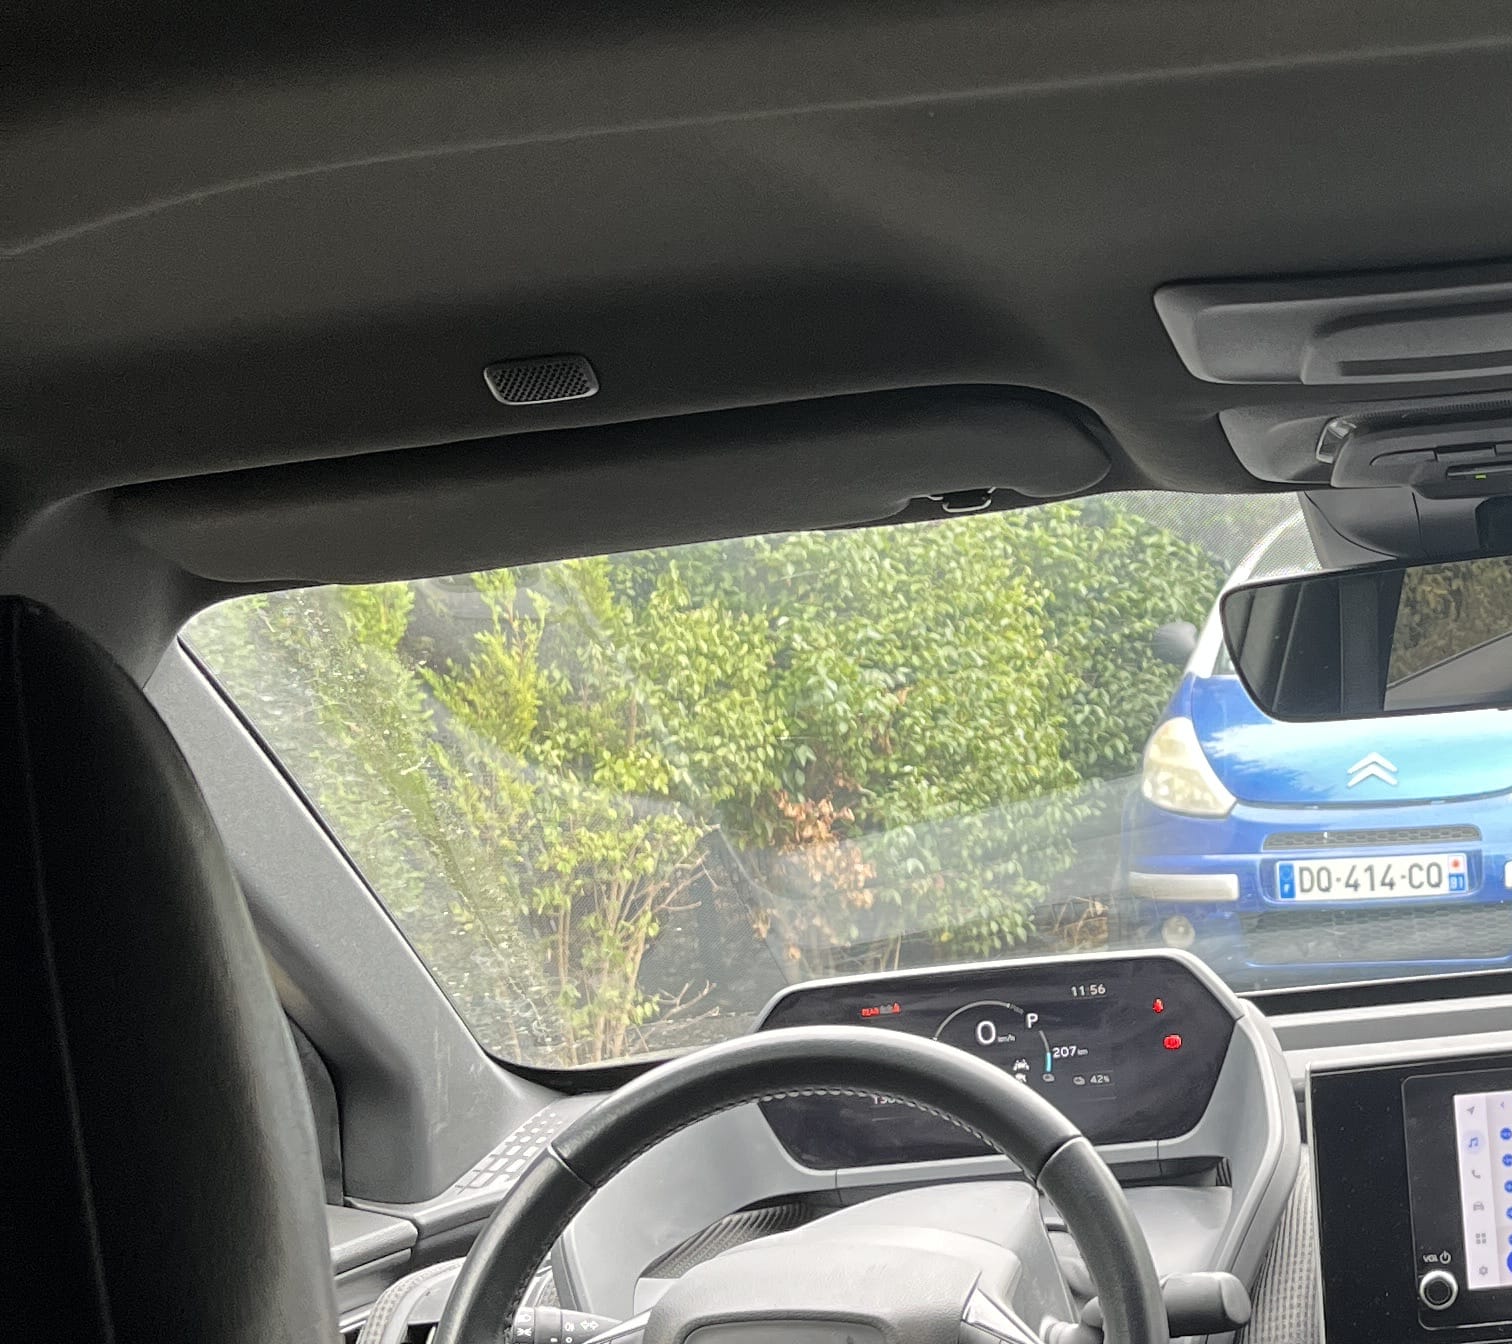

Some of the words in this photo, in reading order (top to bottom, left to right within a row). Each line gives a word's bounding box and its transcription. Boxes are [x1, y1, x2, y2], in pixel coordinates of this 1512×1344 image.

[1298, 861, 1443, 894] DQ-414-CQ
[1026, 1013, 1039, 1029] P
[976, 1020, 997, 1046] 0
[1052, 1045, 1078, 1058] 207
